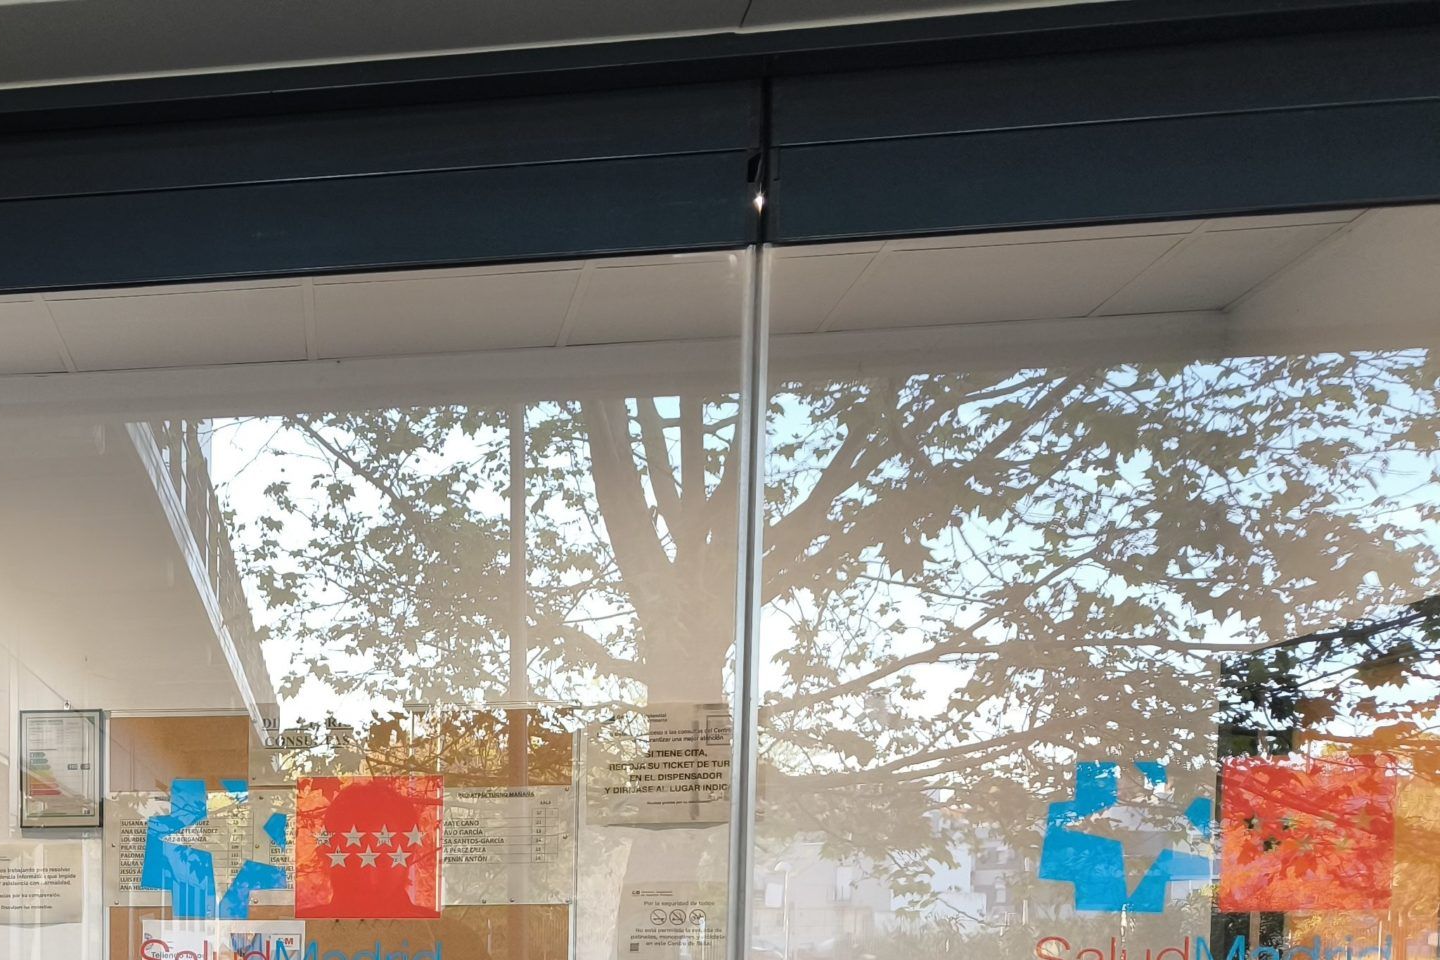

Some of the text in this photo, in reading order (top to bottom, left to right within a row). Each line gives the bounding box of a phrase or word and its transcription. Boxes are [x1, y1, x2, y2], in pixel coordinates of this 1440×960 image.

[265, 735, 351, 748] CONSUTAS
[684, 749, 708, 757] CITA,
[662, 761, 695, 769] TICKET
[697, 760, 709, 768] DE
[712, 760, 731, 768] TUR
[629, 774, 642, 782] EN
[657, 772, 723, 781] DISPENSADOR
[669, 784, 701, 792] LUGAR
